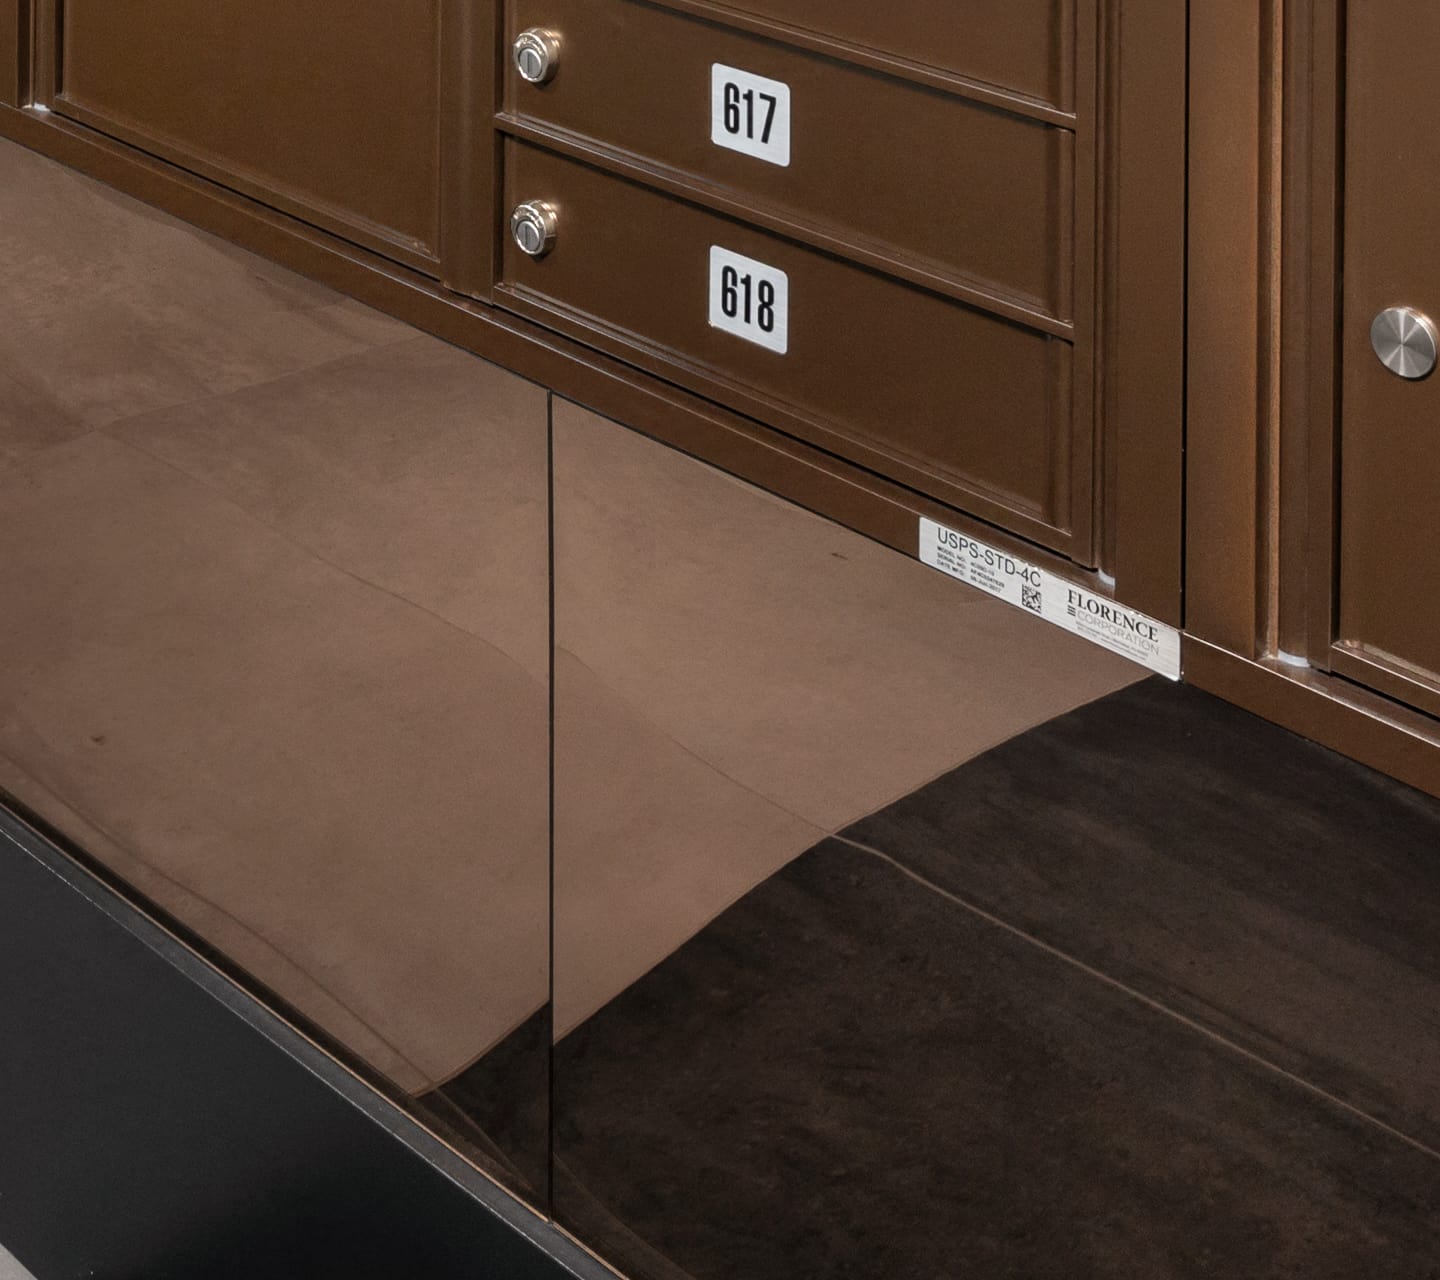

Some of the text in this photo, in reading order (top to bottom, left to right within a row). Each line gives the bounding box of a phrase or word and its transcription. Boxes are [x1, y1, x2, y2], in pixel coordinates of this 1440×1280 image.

[723, 81, 777, 145] 617
[721, 264, 775, 333] 618
[938, 527, 1041, 587] USPS-STD-4C
[1068, 589, 1159, 642] FLORENCE
[1077, 610, 1159, 655] CORPORATION
